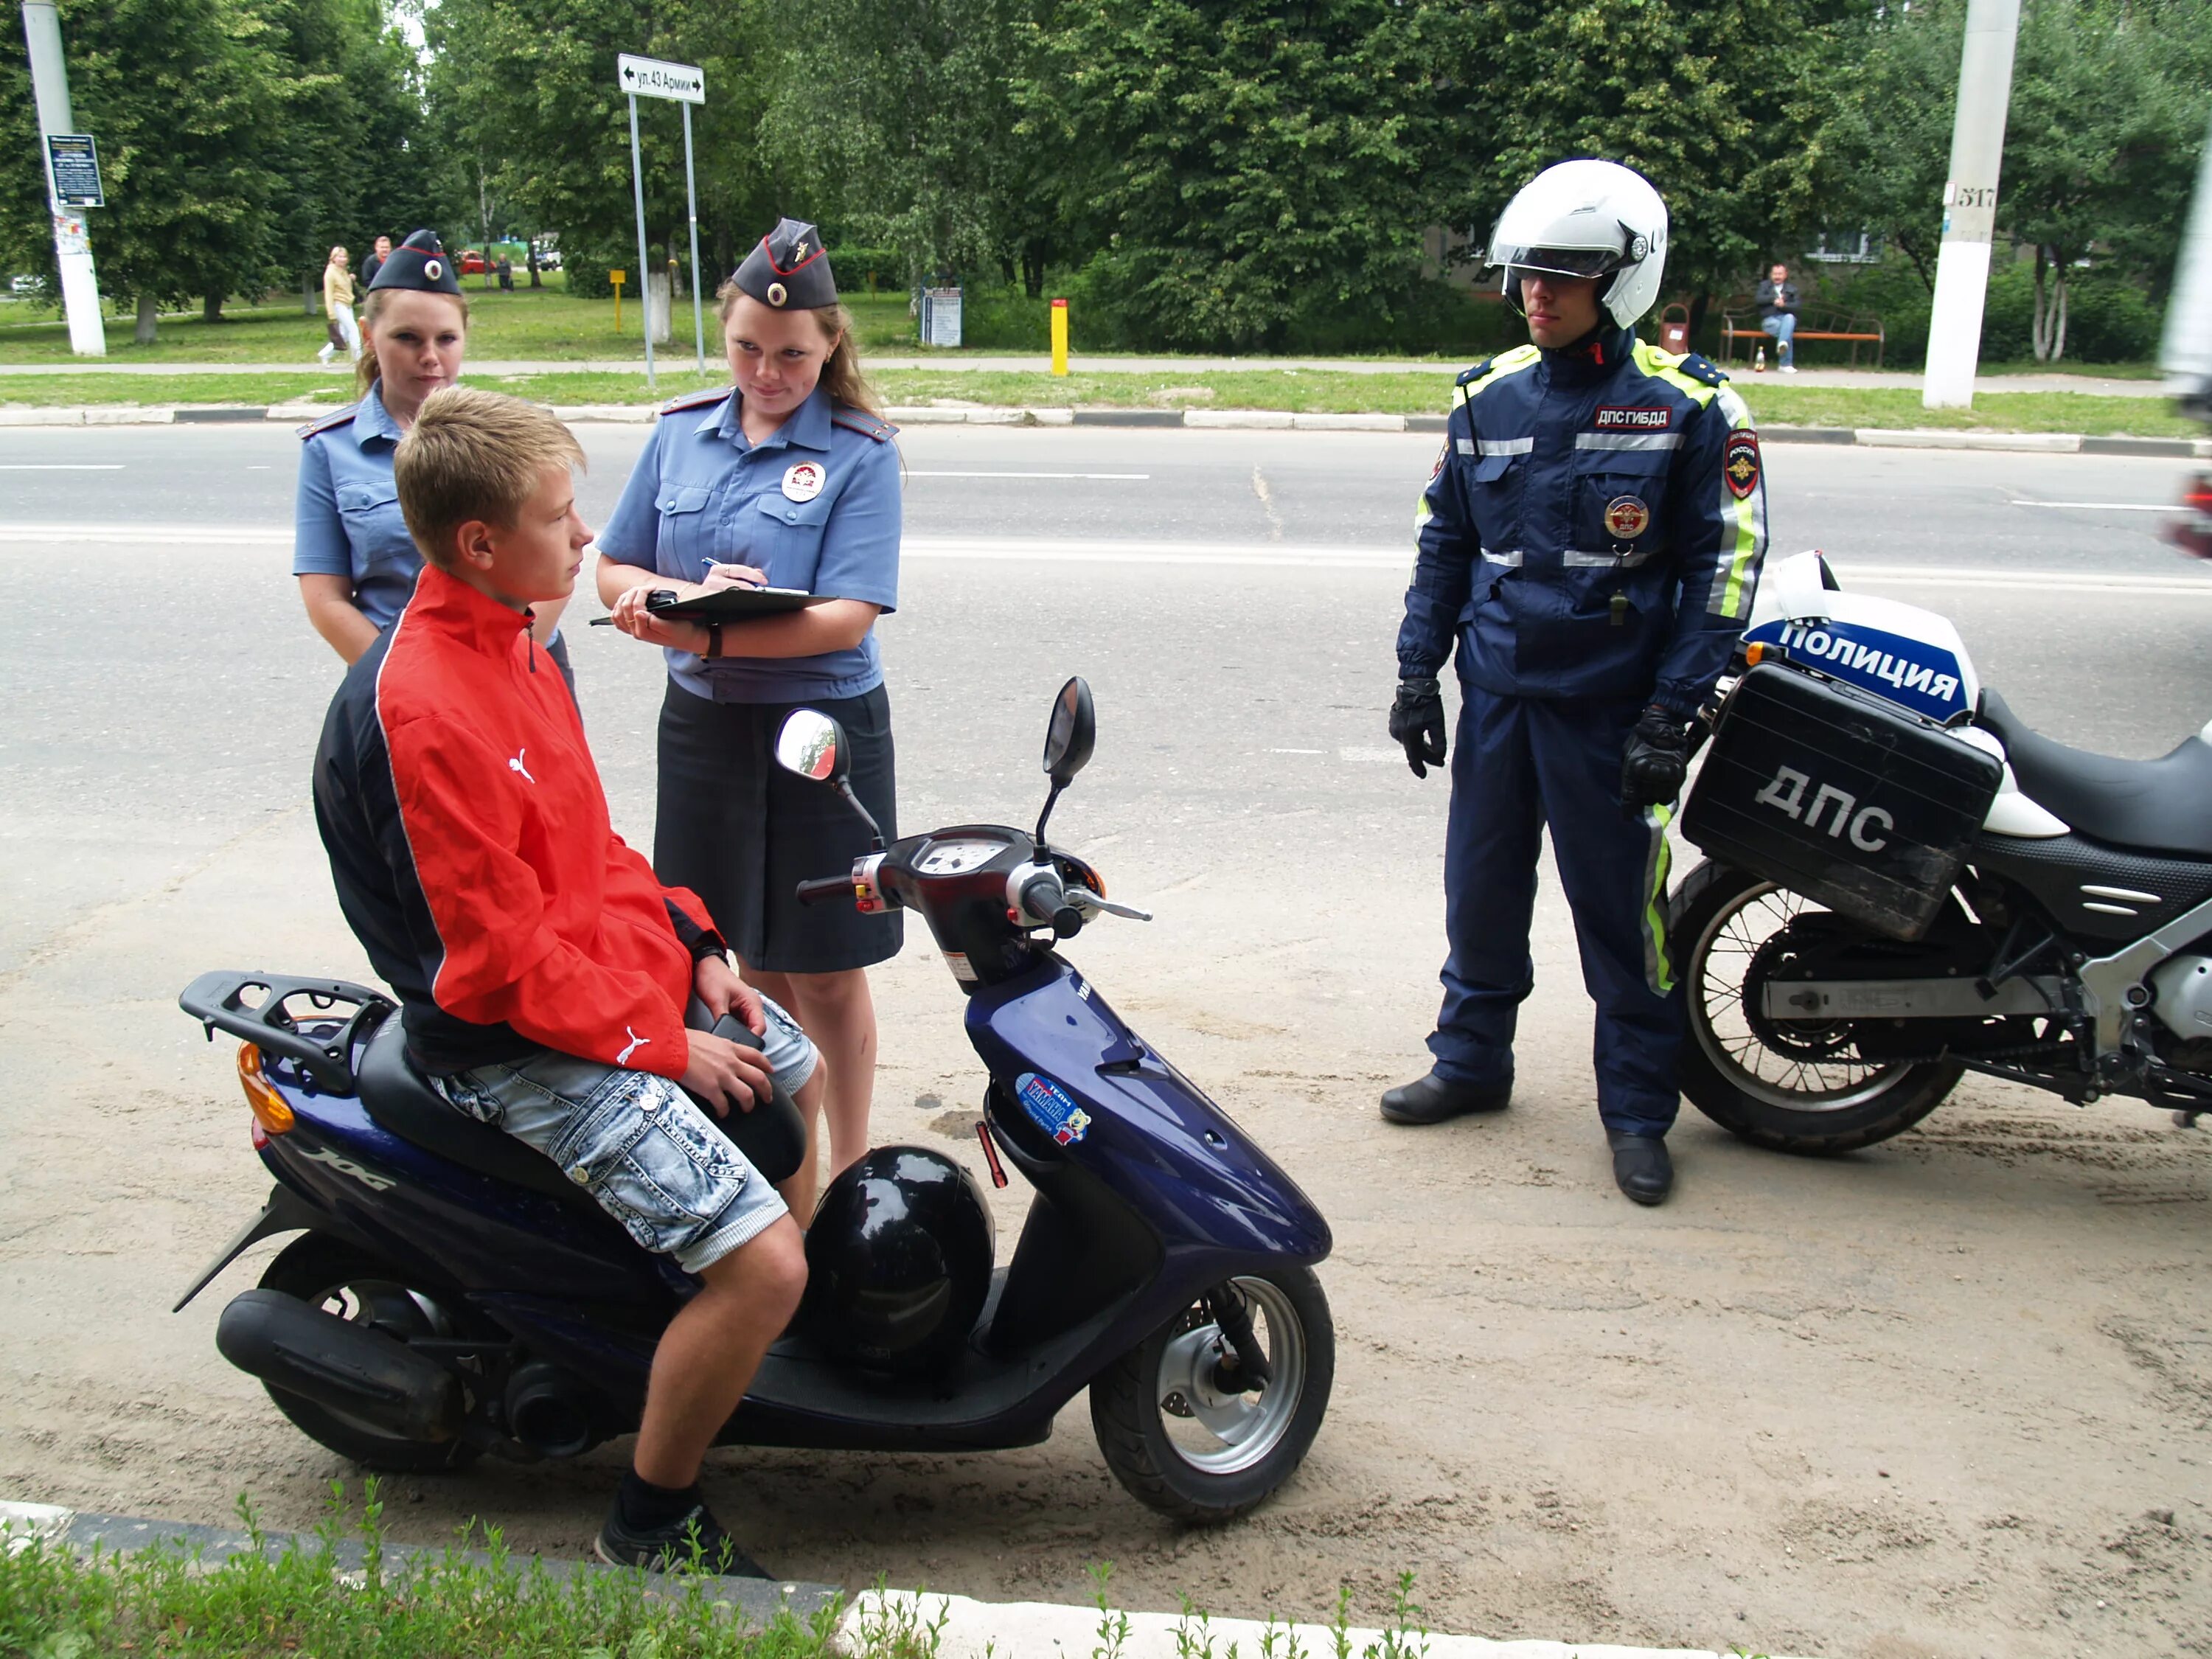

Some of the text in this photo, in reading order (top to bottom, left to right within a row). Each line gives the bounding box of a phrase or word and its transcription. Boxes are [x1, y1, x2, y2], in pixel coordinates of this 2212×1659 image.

[664, 72, 691, 93] Армии
[1959, 188, 1994, 207] 517
[1598, 410, 1667, 426] ДПС ГИБДД
[1730, 446, 1755, 458] РОССИЯ
[1778, 622, 1958, 702] ПОЛИЦИЯ
[1754, 765, 1894, 852] ДПС
[1027, 1081, 1066, 1121] YAMAHA
[1049, 1085, 1071, 1107] TEAM
[298, 1147, 397, 1192] JOG
